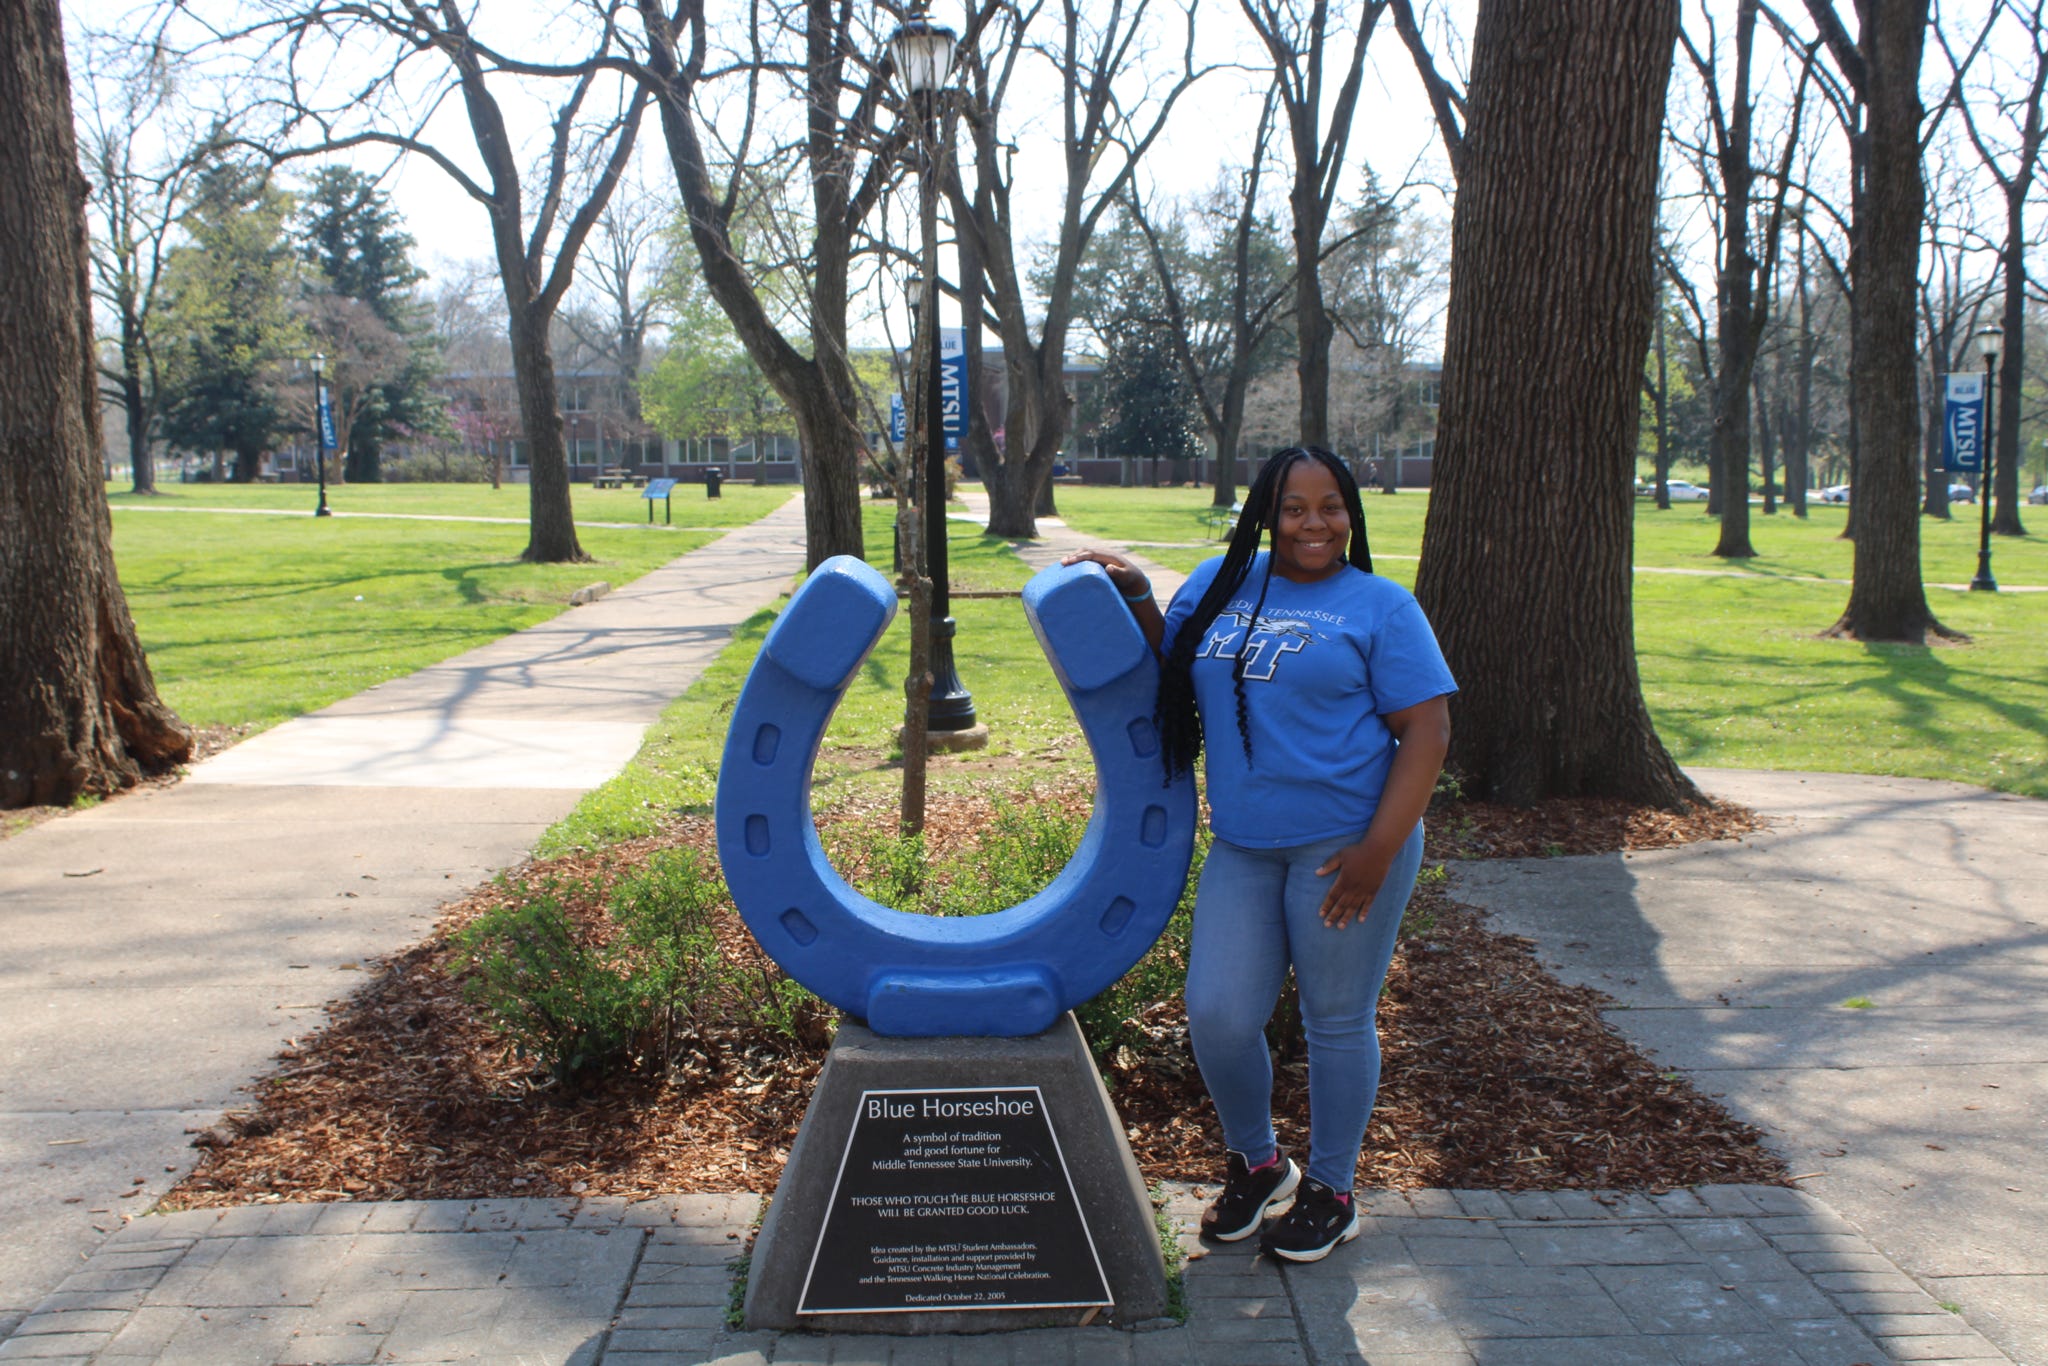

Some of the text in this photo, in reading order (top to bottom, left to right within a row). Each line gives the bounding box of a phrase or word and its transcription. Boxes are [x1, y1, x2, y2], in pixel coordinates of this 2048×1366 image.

[941, 364, 960, 432] MTSU
[1957, 407, 1976, 466] MTSU
[1267, 607, 1347, 626] TENNESSEE
[868, 1095, 1034, 1119] Blue Horseshoe
[903, 1131, 1001, 1145] A symbol of tradition
[903, 1144, 1001, 1157] and good fortune for
[872, 1156, 1033, 1171] Middle Tennessee State University.
[851, 1191, 1056, 1207] THOSE WHO TOUCH THE BLUE HORSESHOE
[877, 1204, 1030, 1218] WILL BE GRANTED GOOD LUCK.
[871, 1246, 886, 1255] Idea
[887, 1245, 915, 1254] created
[915, 1245, 924, 1256] by
[925, 1245, 937, 1253] the
[938, 1243, 961, 1253] MTSU
[962, 1242, 989, 1252] Student
[911, 1254, 950, 1263] installation
[951, 1253, 965, 1262] and
[966, 1253, 993, 1264] support
[994, 1251, 1026, 1262] provided
[1026, 1252, 1036, 1262] by
[888, 1262, 1022, 1274] MTSU Concrete Industry Management
[859, 1275, 873, 1284] and
[874, 1274, 886, 1284] the
[887, 1274, 922, 1283] Tennessee
[923, 1273, 953, 1285] Walking
[954, 1273, 975, 1282] Horse
[977, 1272, 1007, 1281] National
[905, 1293, 942, 1303] Dedicated
[943, 1292, 972, 1302] October
